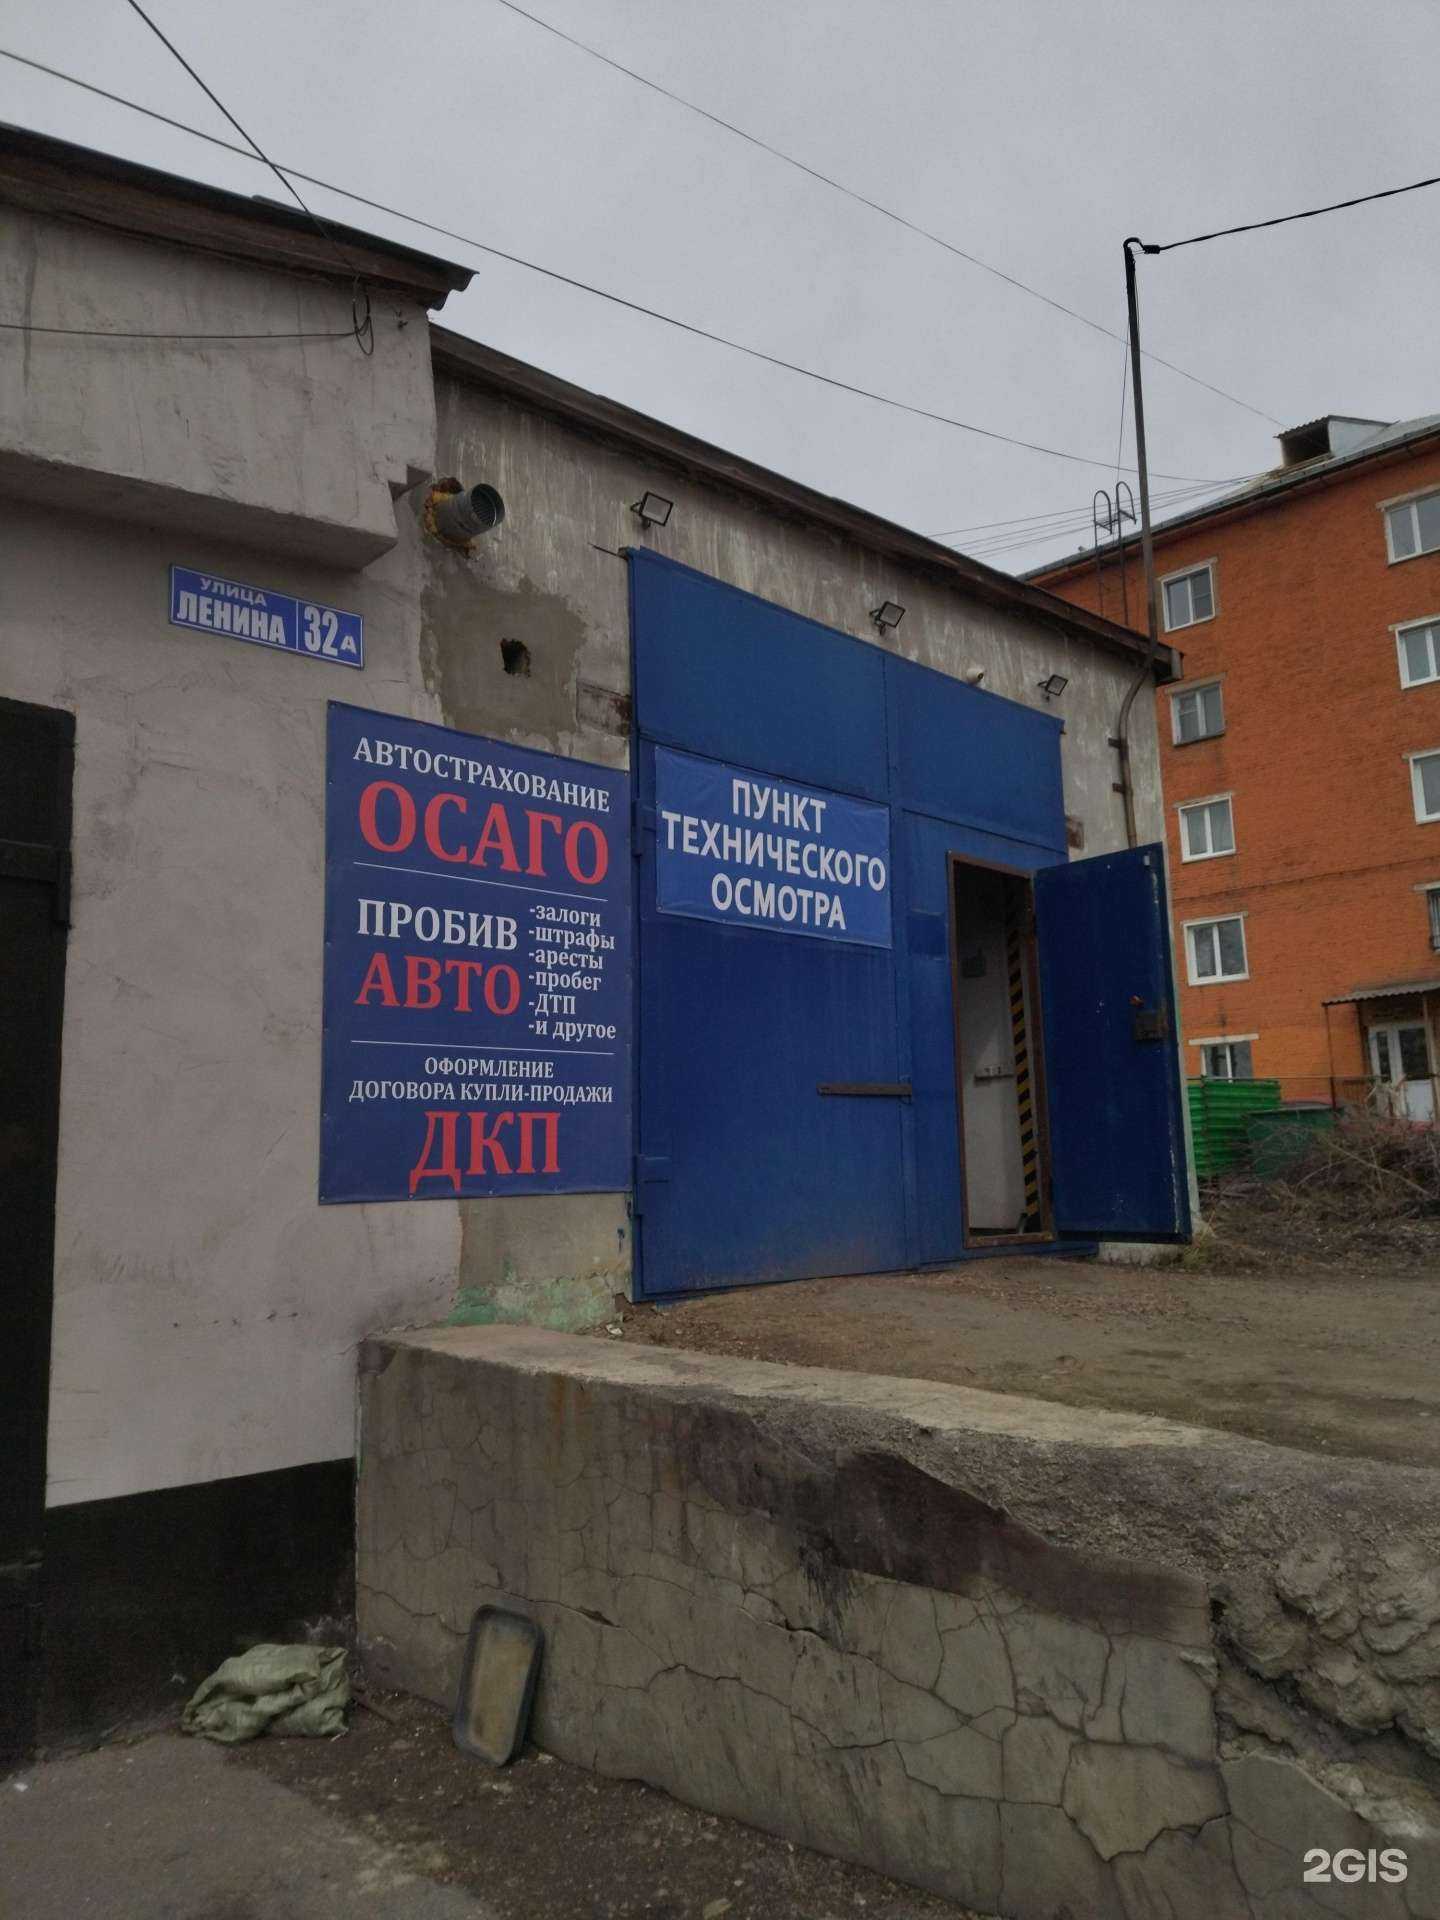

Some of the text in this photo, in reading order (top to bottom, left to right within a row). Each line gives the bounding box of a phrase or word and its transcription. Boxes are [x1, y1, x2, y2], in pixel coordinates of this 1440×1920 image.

[200, 577, 267, 607] УЛИЦА
[177, 590, 286, 645] ЛЕНИНА
[353, 737, 610, 813] АВТОСТРАХОВАНИЕ
[732, 778, 827, 834] ПУНКТ
[358, 780, 609, 886] ОСАГО
[661, 810, 886, 892] ТЕХНИЧЕСКОГО
[529, 905, 601, 928] -залоги
[711, 872, 847, 930] ОСМОТРА
[357, 898, 519, 950] ПРОБИВ
[528, 926, 615, 952] -штрафы
[528, 949, 603, 970] -аресты
[354, 952, 520, 1016] АВТО
[528, 969, 602, 992] -пробег
[528, 993, 576, 1017] -ДТП
[552, 1021, 617, 1041] другое
[424, 1056, 554, 1079] ОФОРМЛЕНИЕ
[349, 1080, 613, 1105] ДОГОВОРА КУПЛИ-ПРОДАЖИ
[409, 1110, 560, 1198] ДКП
